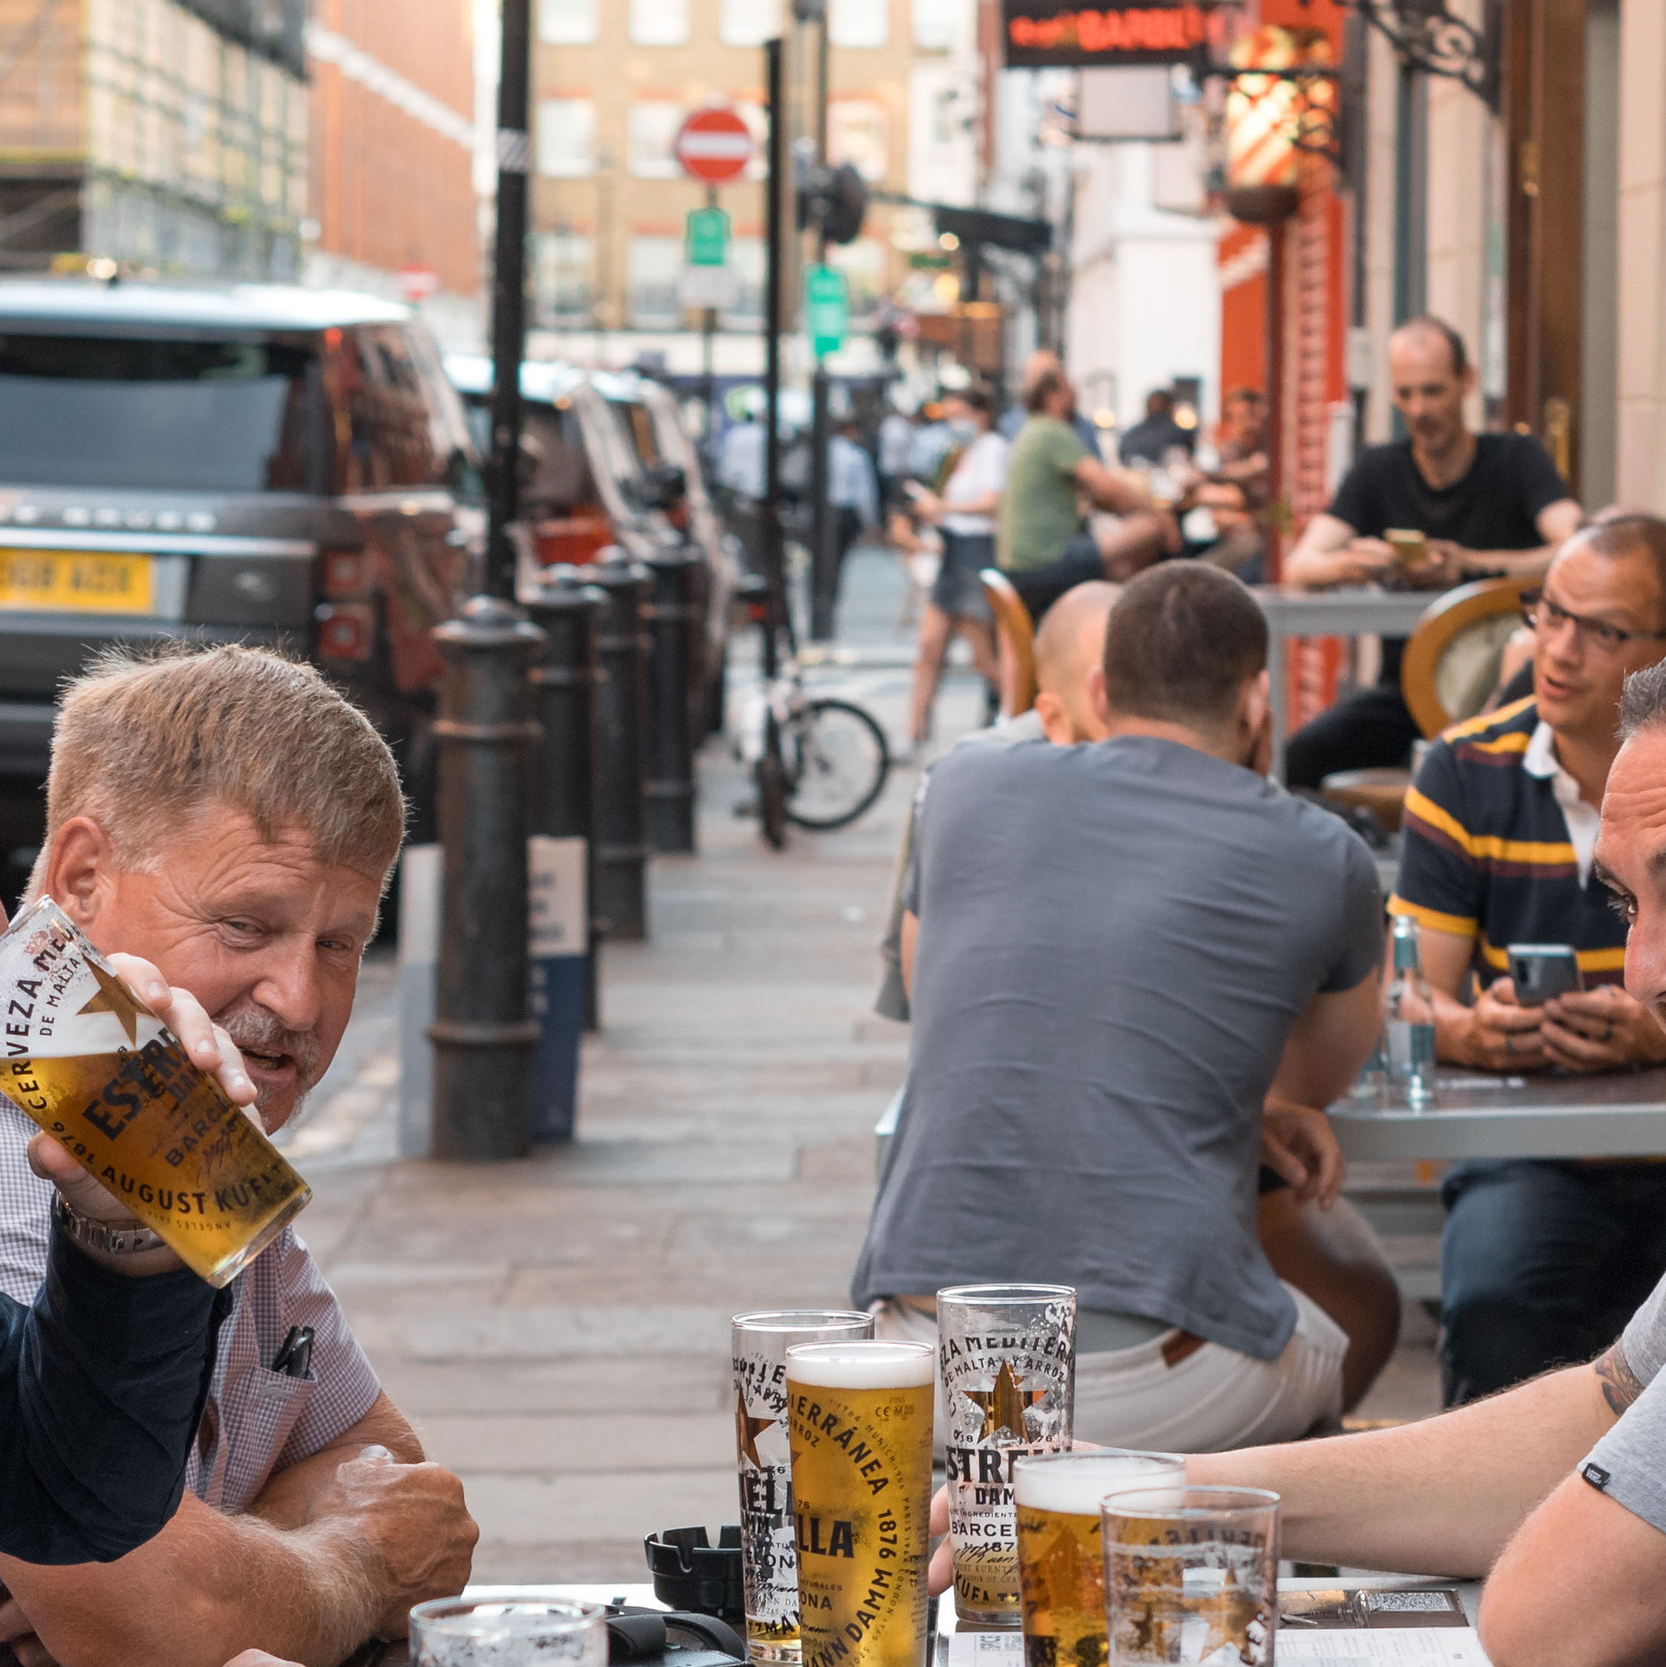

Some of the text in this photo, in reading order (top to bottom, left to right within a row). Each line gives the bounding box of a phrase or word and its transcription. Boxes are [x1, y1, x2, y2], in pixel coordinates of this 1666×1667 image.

[39, 957, 81, 1037] DE MALTA
[6, 978, 48, 1110] CERVEZA
[101, 1166, 206, 1215] AUGUST
[954, 1356, 996, 1377] MALTA
[1023, 1357, 1066, 1382] ARROZ
[865, 1424, 896, 1464] MUNICH
[902, 1496, 913, 1532] PARIS
[797, 1500, 811, 1510] 76
[952, 1521, 1018, 1538] BARCE
[878, 1508, 898, 1560] 1876
[844, 1567, 893, 1643] DAMM
